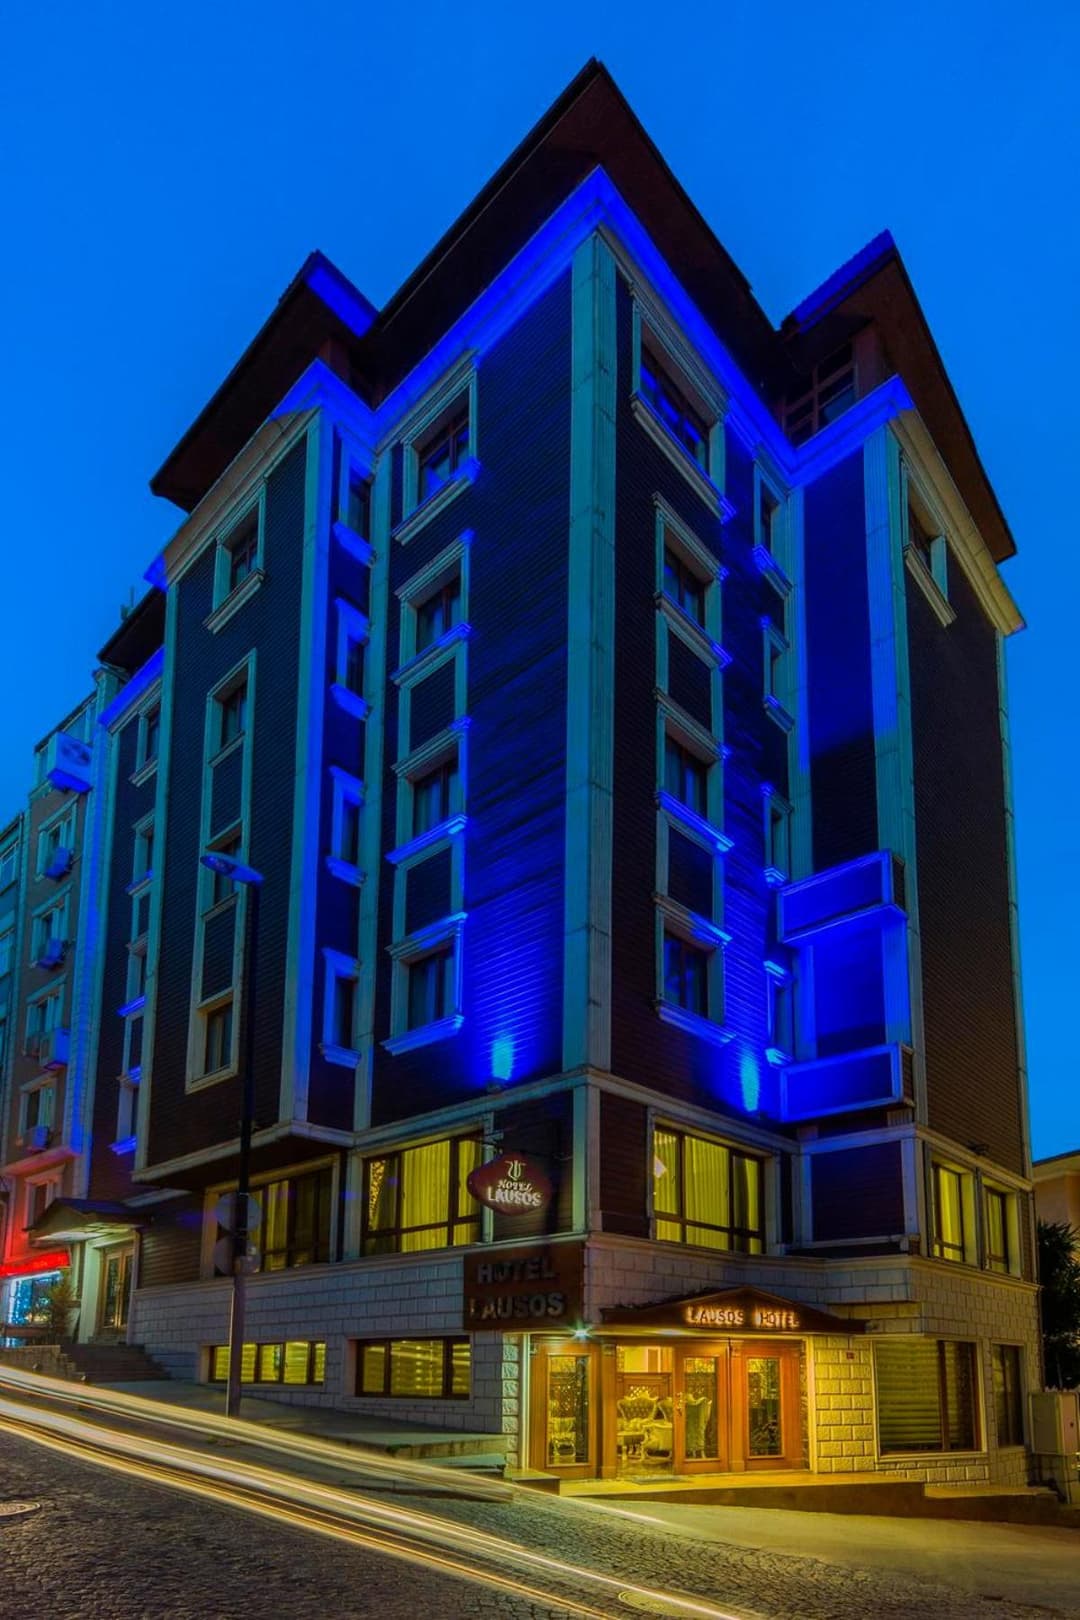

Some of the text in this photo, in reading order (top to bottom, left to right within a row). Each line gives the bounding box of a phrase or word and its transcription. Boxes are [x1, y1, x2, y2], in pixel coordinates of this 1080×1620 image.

[487, 1186, 543, 1206] LAUSOS
[479, 1257, 555, 1284] HOTEL
[686, 1306, 800, 1328] LAUSOS HOTEL
